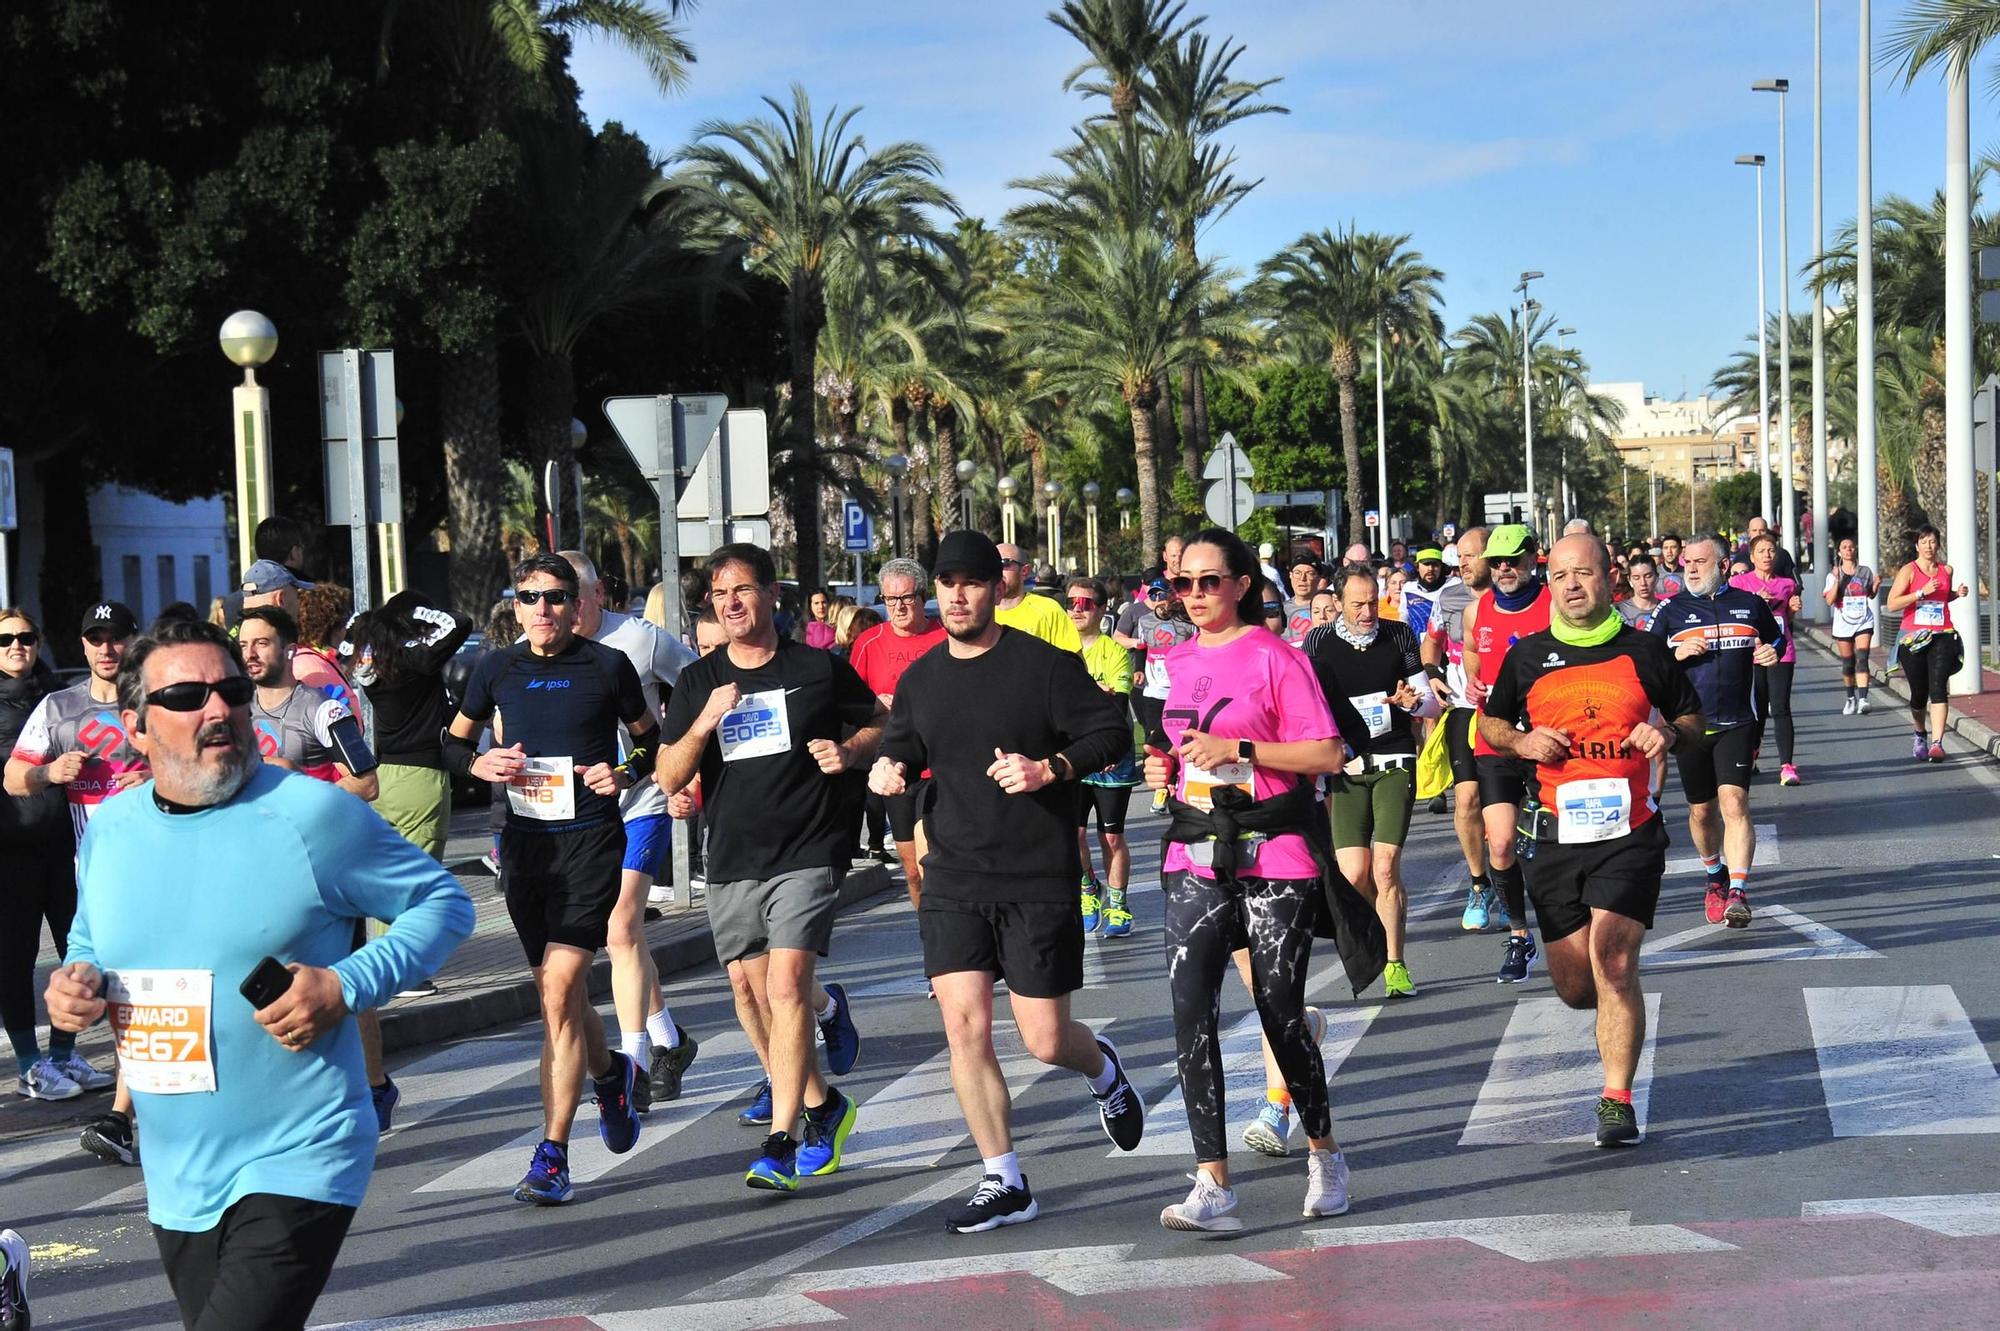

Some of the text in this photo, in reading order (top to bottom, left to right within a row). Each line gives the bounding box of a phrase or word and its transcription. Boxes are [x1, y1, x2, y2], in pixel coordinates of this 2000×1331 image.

[848, 505, 864, 536] P
[546, 680, 570, 691] ipso
[1568, 809, 1621, 825] 1924
[118, 1007, 188, 1027] EDWARD
